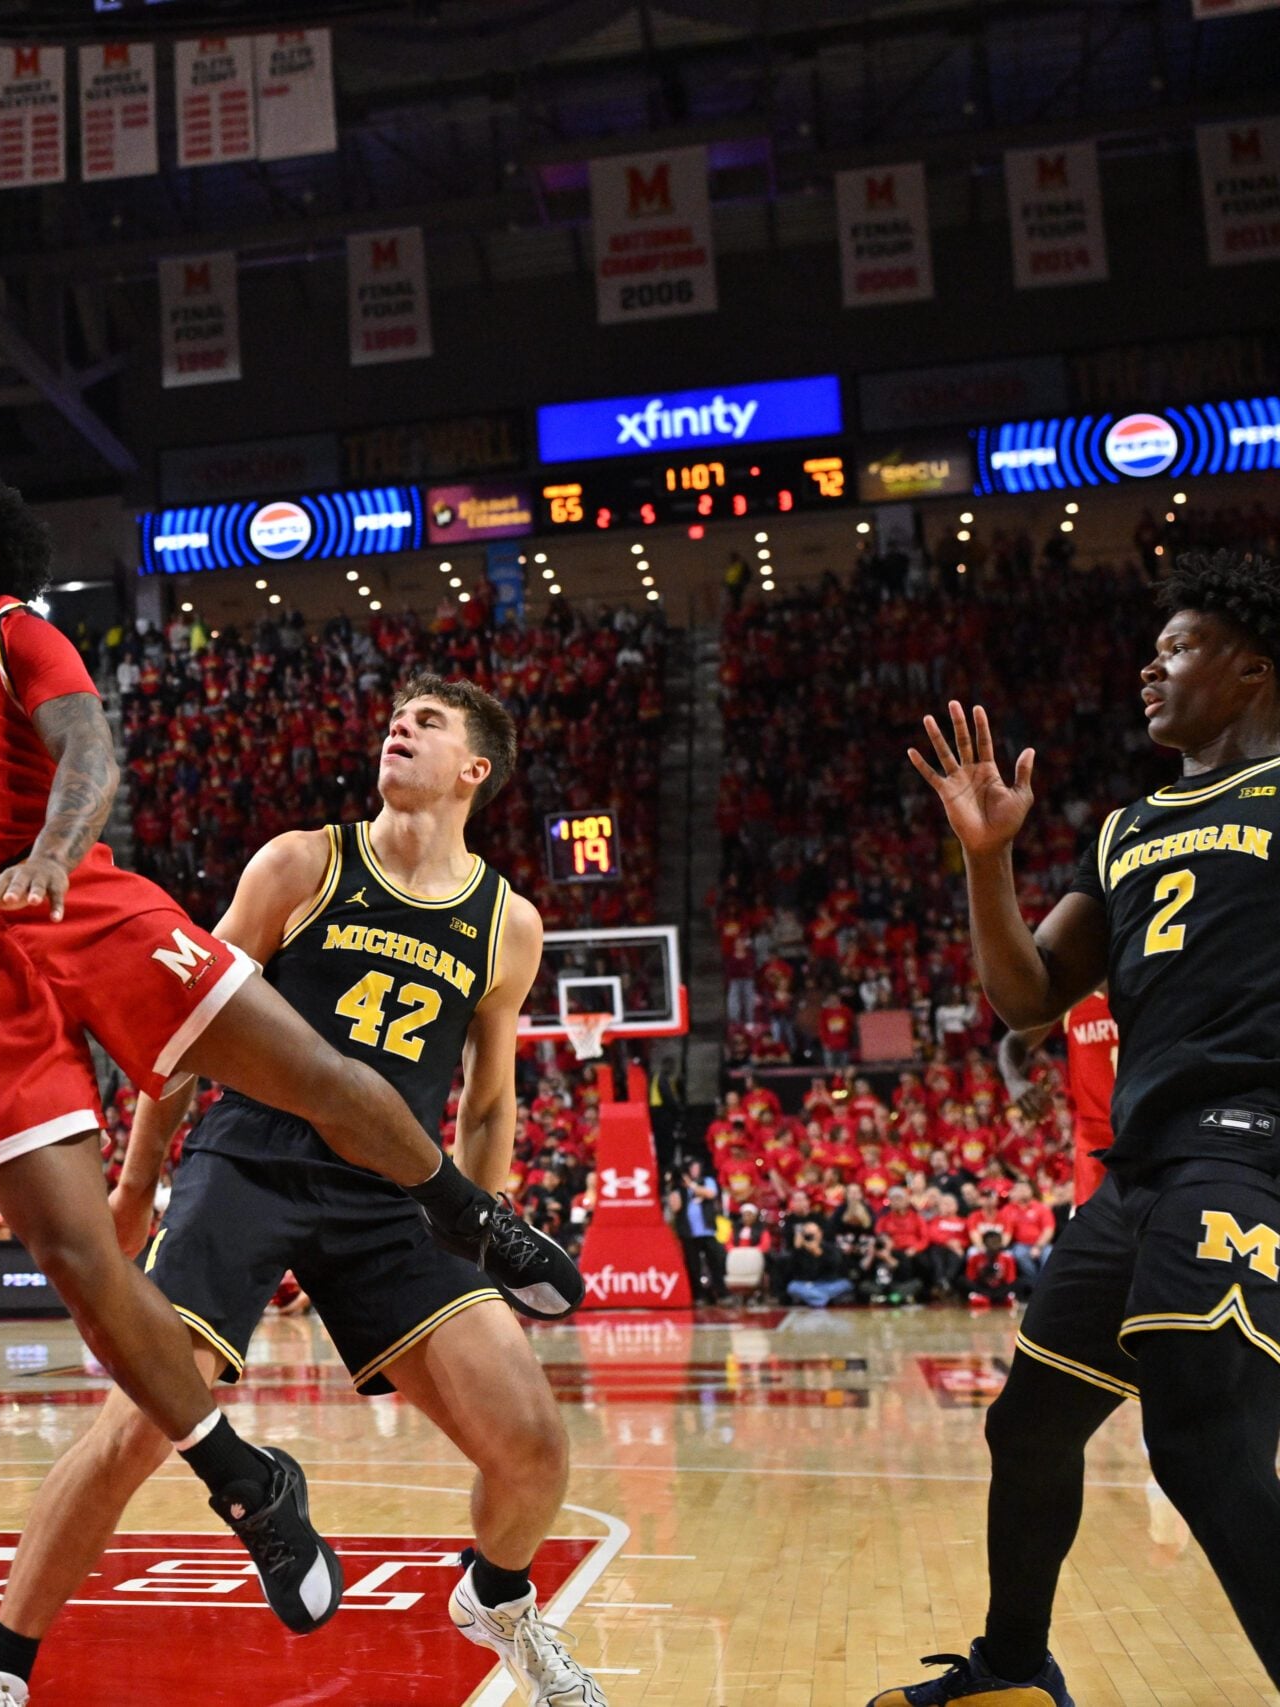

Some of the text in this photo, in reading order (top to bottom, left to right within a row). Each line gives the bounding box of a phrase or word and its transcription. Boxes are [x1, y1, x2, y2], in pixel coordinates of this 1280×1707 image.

[14, 46, 40, 78] M
[1228, 128, 1261, 162] M
[1035, 154, 1068, 189] M
[626, 163, 673, 219] M
[866, 174, 896, 210] M
[850, 218, 915, 239] FINAL
[371, 238, 398, 271] M
[184, 261, 210, 296] M
[358, 281, 416, 300] FINAL
[620, 279, 694, 311] 2006
[169, 304, 225, 323] FINAL
[617, 395, 759, 448] xfinity
[992, 448, 1057, 469] PEPSI
[812, 470, 845, 497] 72
[355, 512, 411, 531] PEPSI
[551, 497, 583, 523] 65
[154, 533, 209, 551] PEPSI
[574, 837, 609, 874] 19
[1109, 824, 1272, 890] MICHIGAN
[1144, 868, 1196, 956] 2
[151, 928, 212, 984] M
[322, 924, 476, 999] MICHIGAN
[335, 970, 442, 1063] 42
[1196, 1209, 1280, 1282] M
[584, 1264, 679, 1301] xfinity
